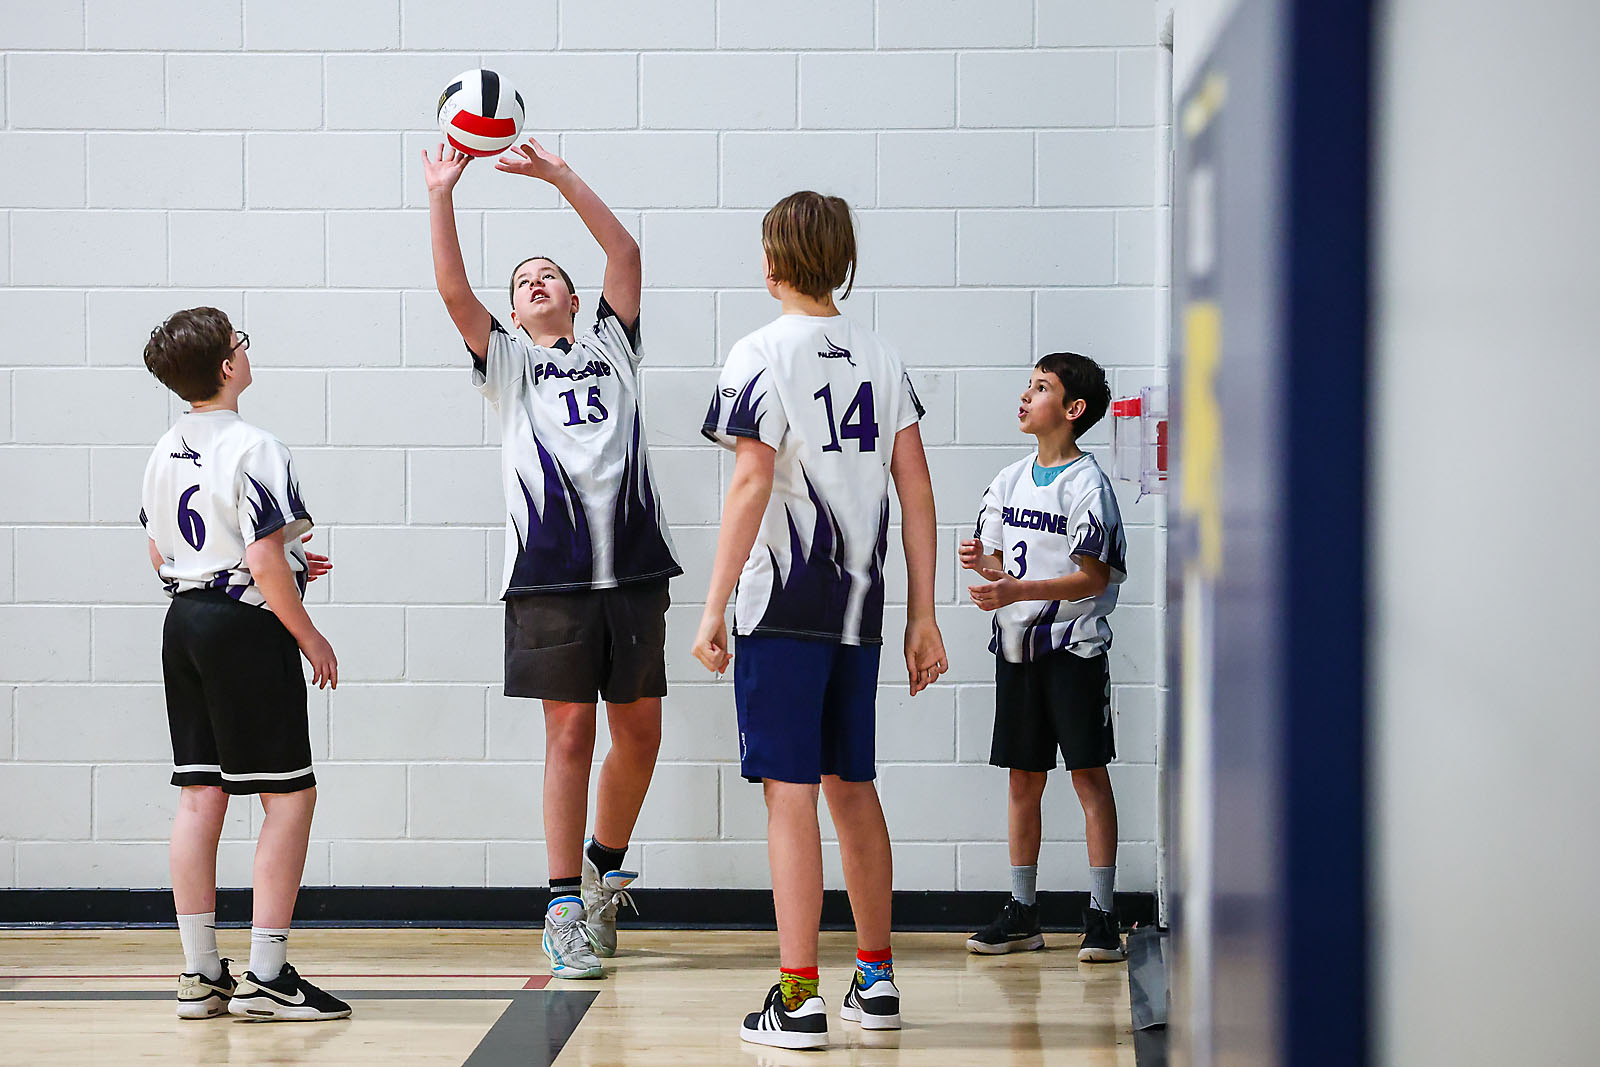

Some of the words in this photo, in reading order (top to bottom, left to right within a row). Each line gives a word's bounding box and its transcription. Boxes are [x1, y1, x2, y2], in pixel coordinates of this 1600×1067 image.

[558, 385, 609, 427] 15
[813, 381, 879, 453] 14
[177, 484, 206, 552] 6
[1007, 540, 1028, 580] 3
